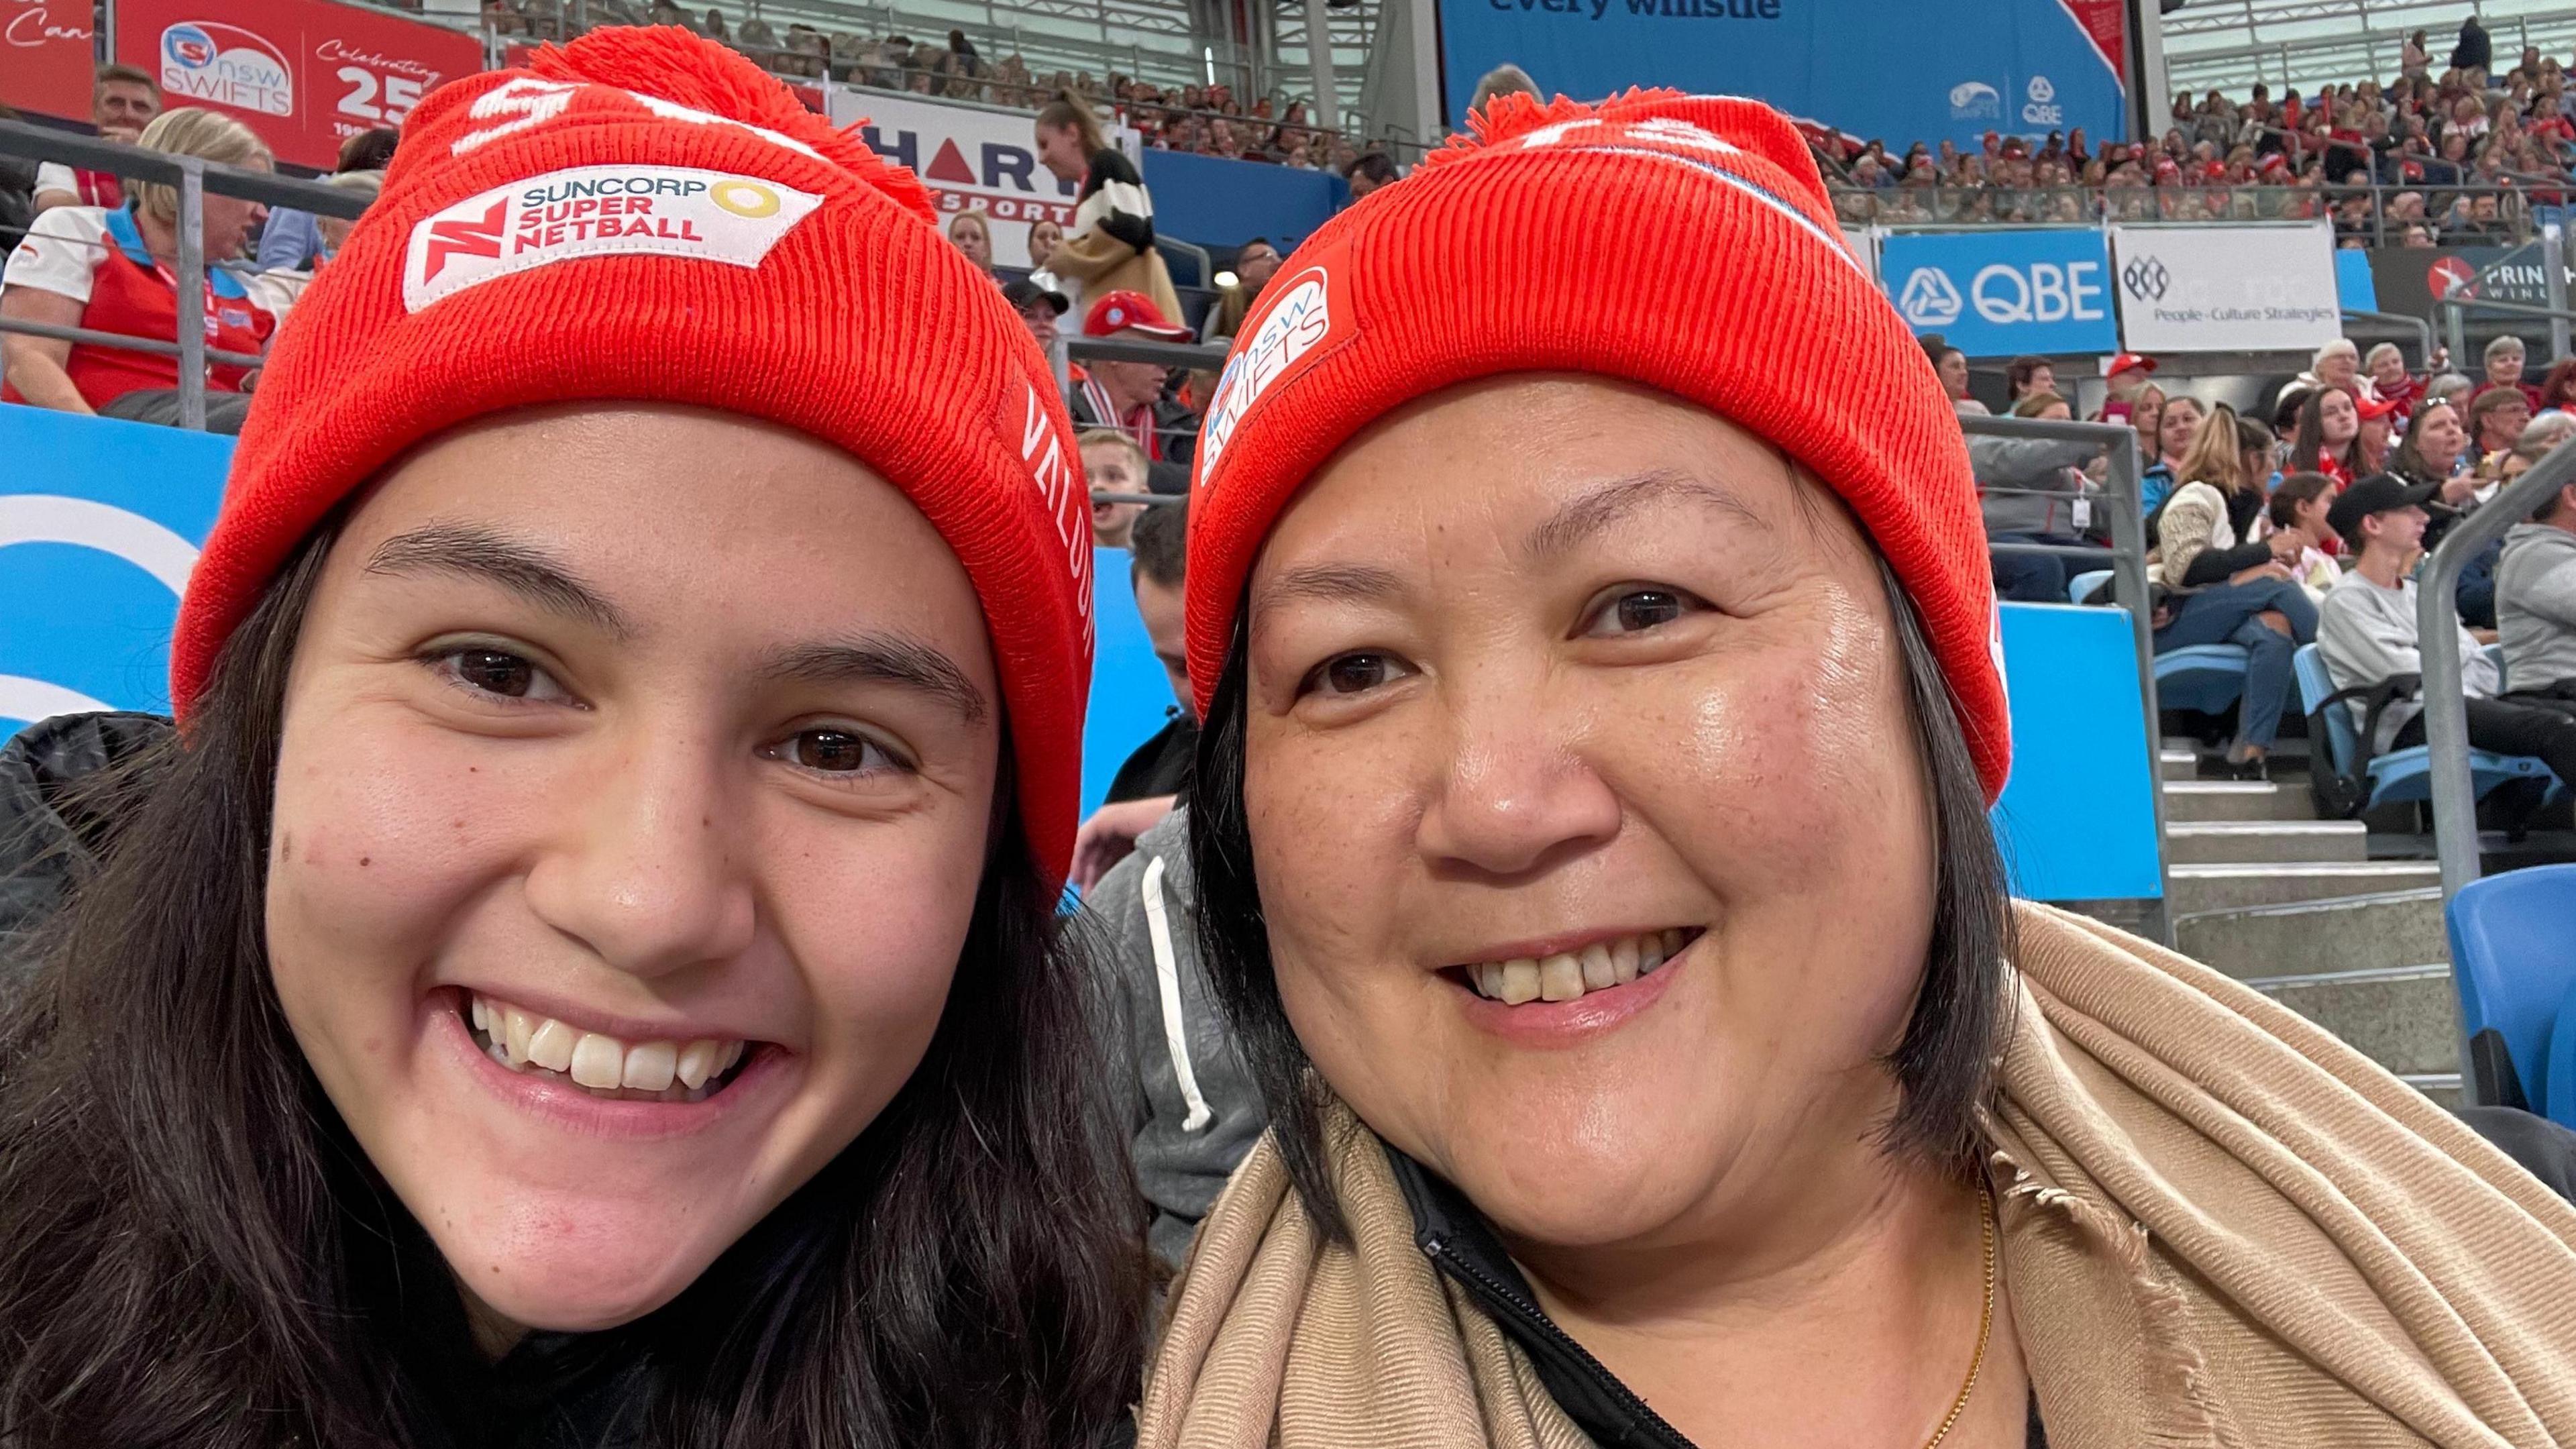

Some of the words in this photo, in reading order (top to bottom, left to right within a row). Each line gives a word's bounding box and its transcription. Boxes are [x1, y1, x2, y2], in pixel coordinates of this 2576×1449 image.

[219, 59, 282, 88] nsw
[315, 39, 440, 88] Celebrating
[164, 67, 290, 115] SWIFTS
[337, 66, 423, 125] 25
[2022, 103, 2063, 125] QBE
[521, 177, 707, 208] SUNCORP
[942, 193, 1073, 223] SPORT
[518, 196, 653, 230] SUPER
[514, 215, 703, 255] NETBALL
[1971, 262, 2105, 324] QBE
[1242, 288, 1313, 380] nsw
[2211, 307, 2261, 321] Culture
[1202, 305, 1326, 482] SWIFTS
